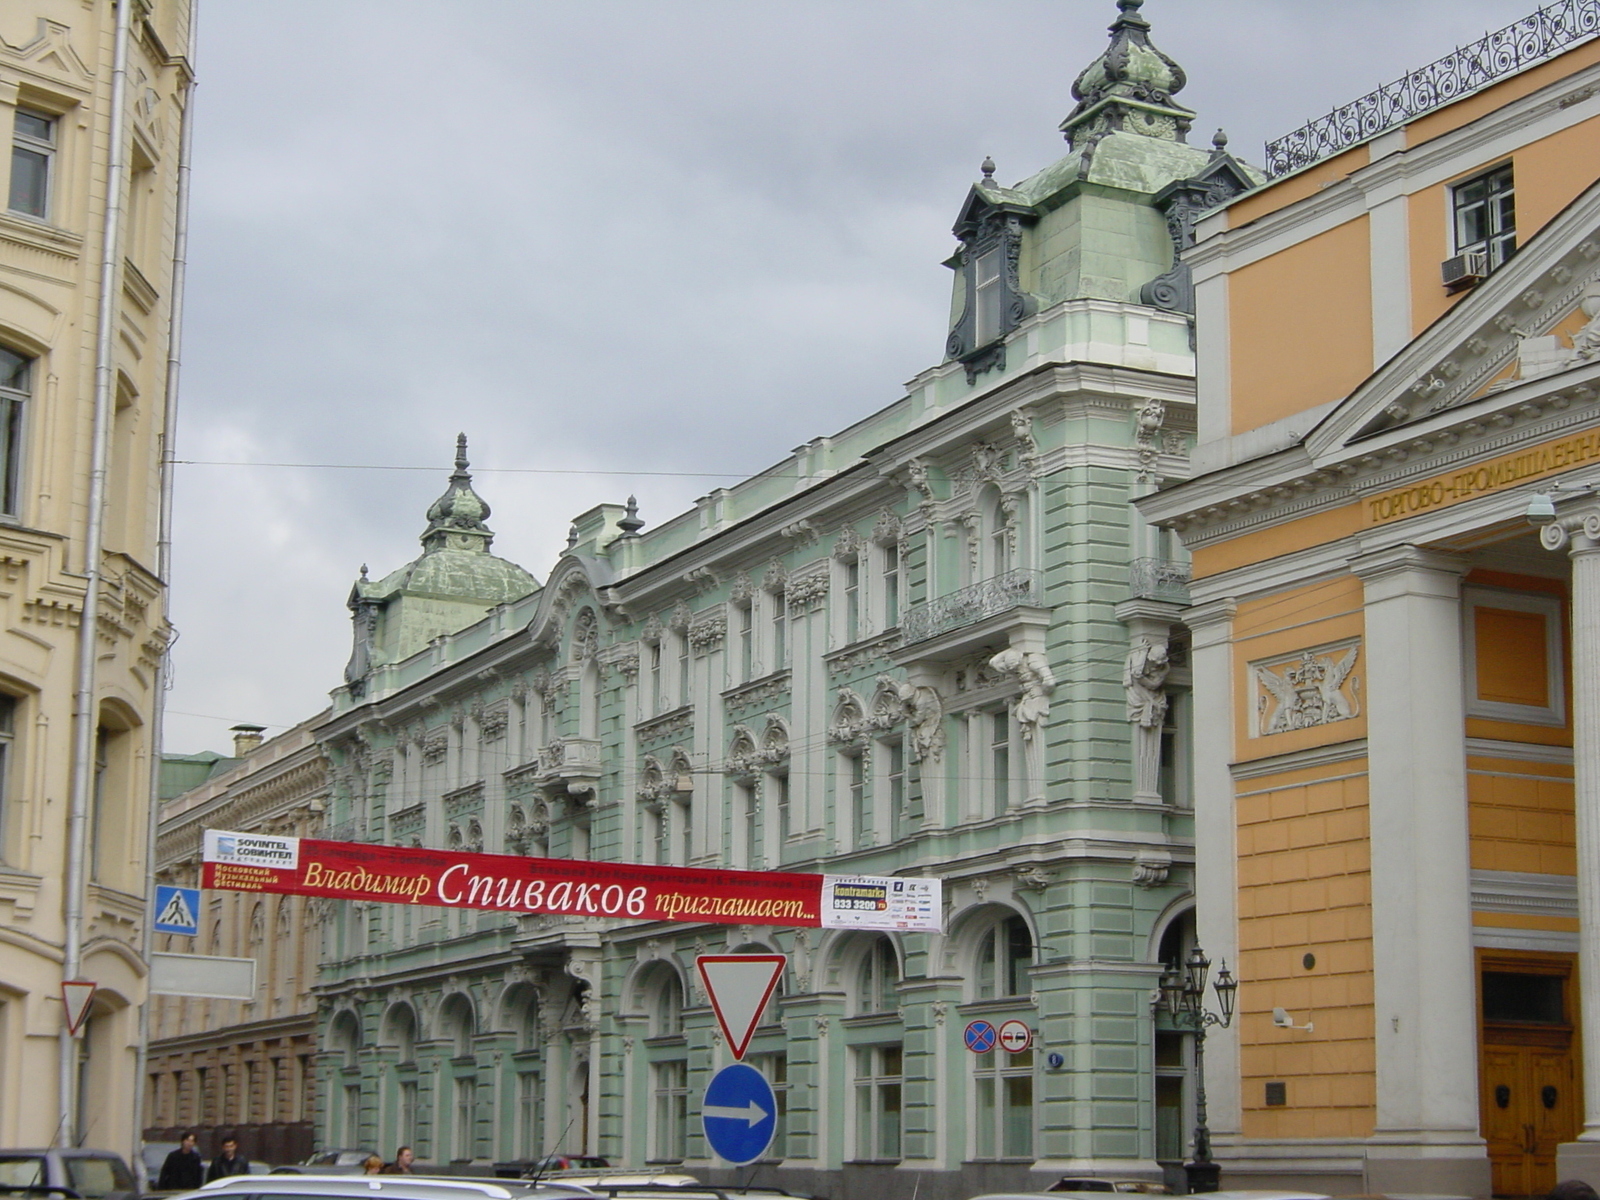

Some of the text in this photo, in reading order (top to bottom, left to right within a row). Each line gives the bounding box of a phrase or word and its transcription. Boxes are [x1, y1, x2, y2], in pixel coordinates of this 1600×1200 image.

[1369, 433, 1600, 522] ТОРГОВО-ПРОМЫШЛЕНН
[237, 838, 289, 850] SOVINTEL
[237, 847, 292, 859] СОВИНТЕЛ
[215, 863, 270, 876] Московский
[214, 871, 279, 884] Музыкальный
[303, 862, 431, 903] Владимир
[437, 863, 648, 916] Спиваков
[834, 885, 885, 898] kontramarka
[834, 898, 852, 909] 933
[853, 899, 876, 910] 3200
